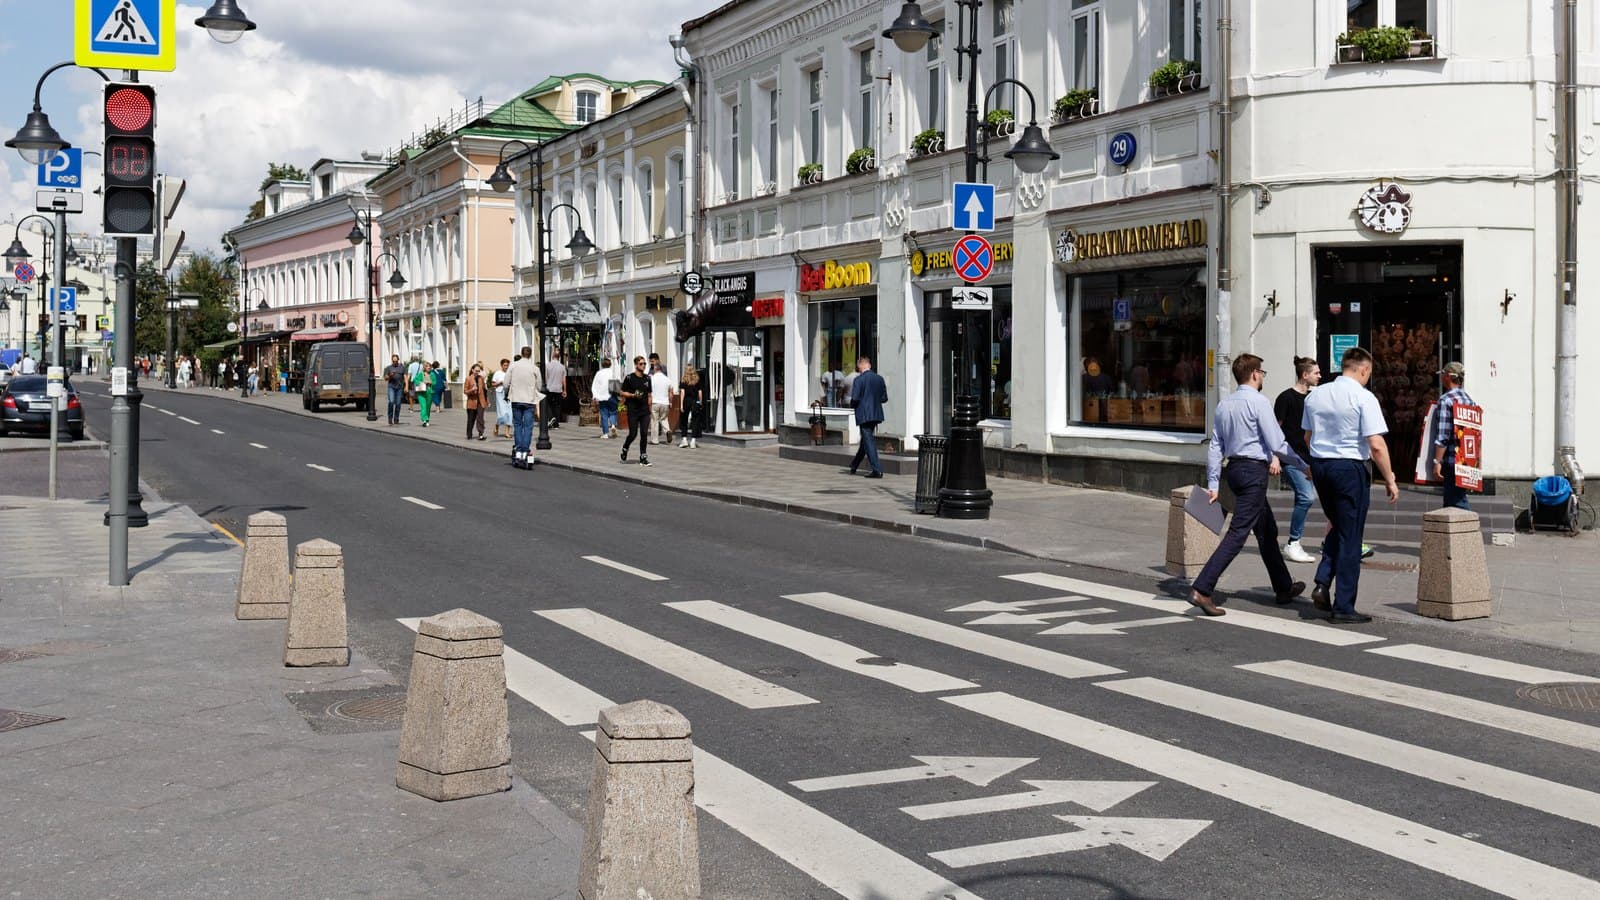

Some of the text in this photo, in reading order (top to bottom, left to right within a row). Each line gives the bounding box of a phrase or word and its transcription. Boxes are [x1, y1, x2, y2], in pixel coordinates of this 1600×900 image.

[112, 145, 146, 177] 02
[1113, 139, 1126, 158] 29
[1076, 218, 1204, 260] PIRATMARMELAD
[927, 242, 1013, 270] FREN ERY
[714, 278, 730, 293] BLACK
[730, 275, 747, 291] ANGUS
[800, 259, 871, 292] BetBoom
[1457, 407, 1480, 423] ЦВЕТЫ
